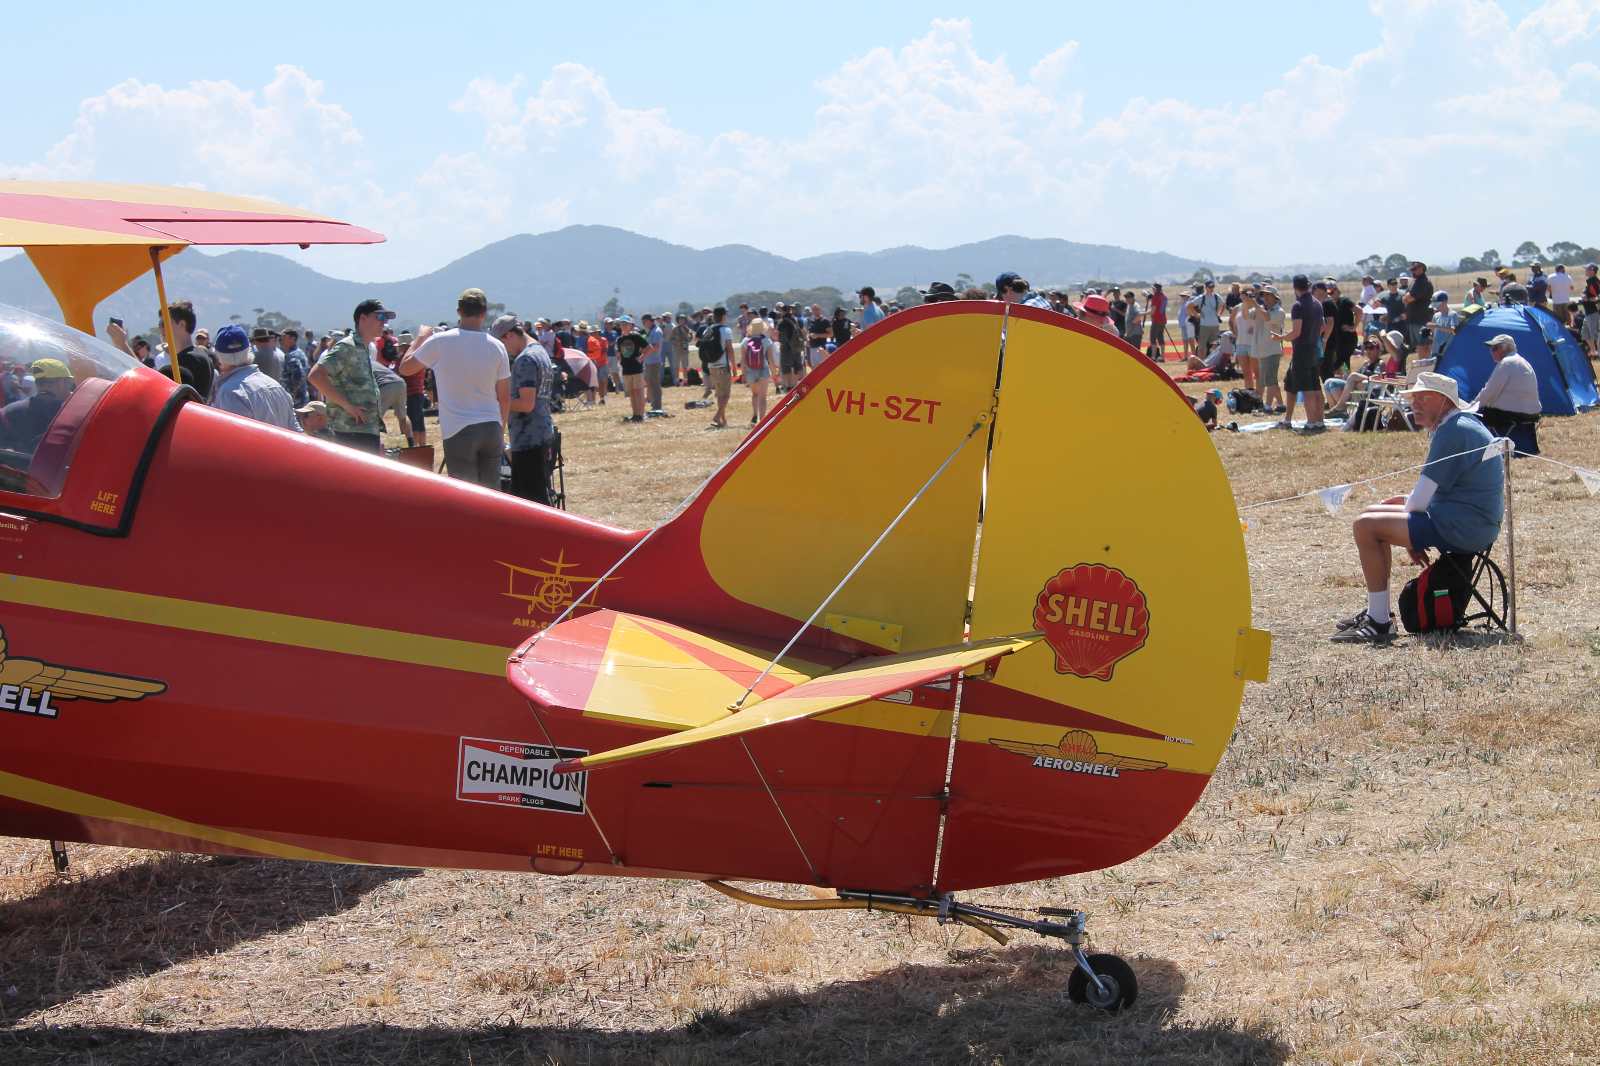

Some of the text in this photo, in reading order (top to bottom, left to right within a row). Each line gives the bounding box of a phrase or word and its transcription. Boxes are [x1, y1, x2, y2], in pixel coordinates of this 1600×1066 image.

[826, 388, 942, 424] VH-SZT
[97, 490, 119, 503] LIFT
[90, 501, 116, 515] HERE
[1045, 592, 1138, 637] SHELL
[1068, 629, 1110, 641] GASOLINE
[1175, 737, 1194, 745] PUSH
[499, 745, 550, 757] DEPENDABLE
[1061, 742, 1096, 756] SHELL
[1032, 755, 1120, 778] AEROSHELL
[467, 760, 581, 793] CHAMPION
[498, 794, 544, 806] SPARK PLUGS
[537, 844, 584, 858] LIFT HERE
